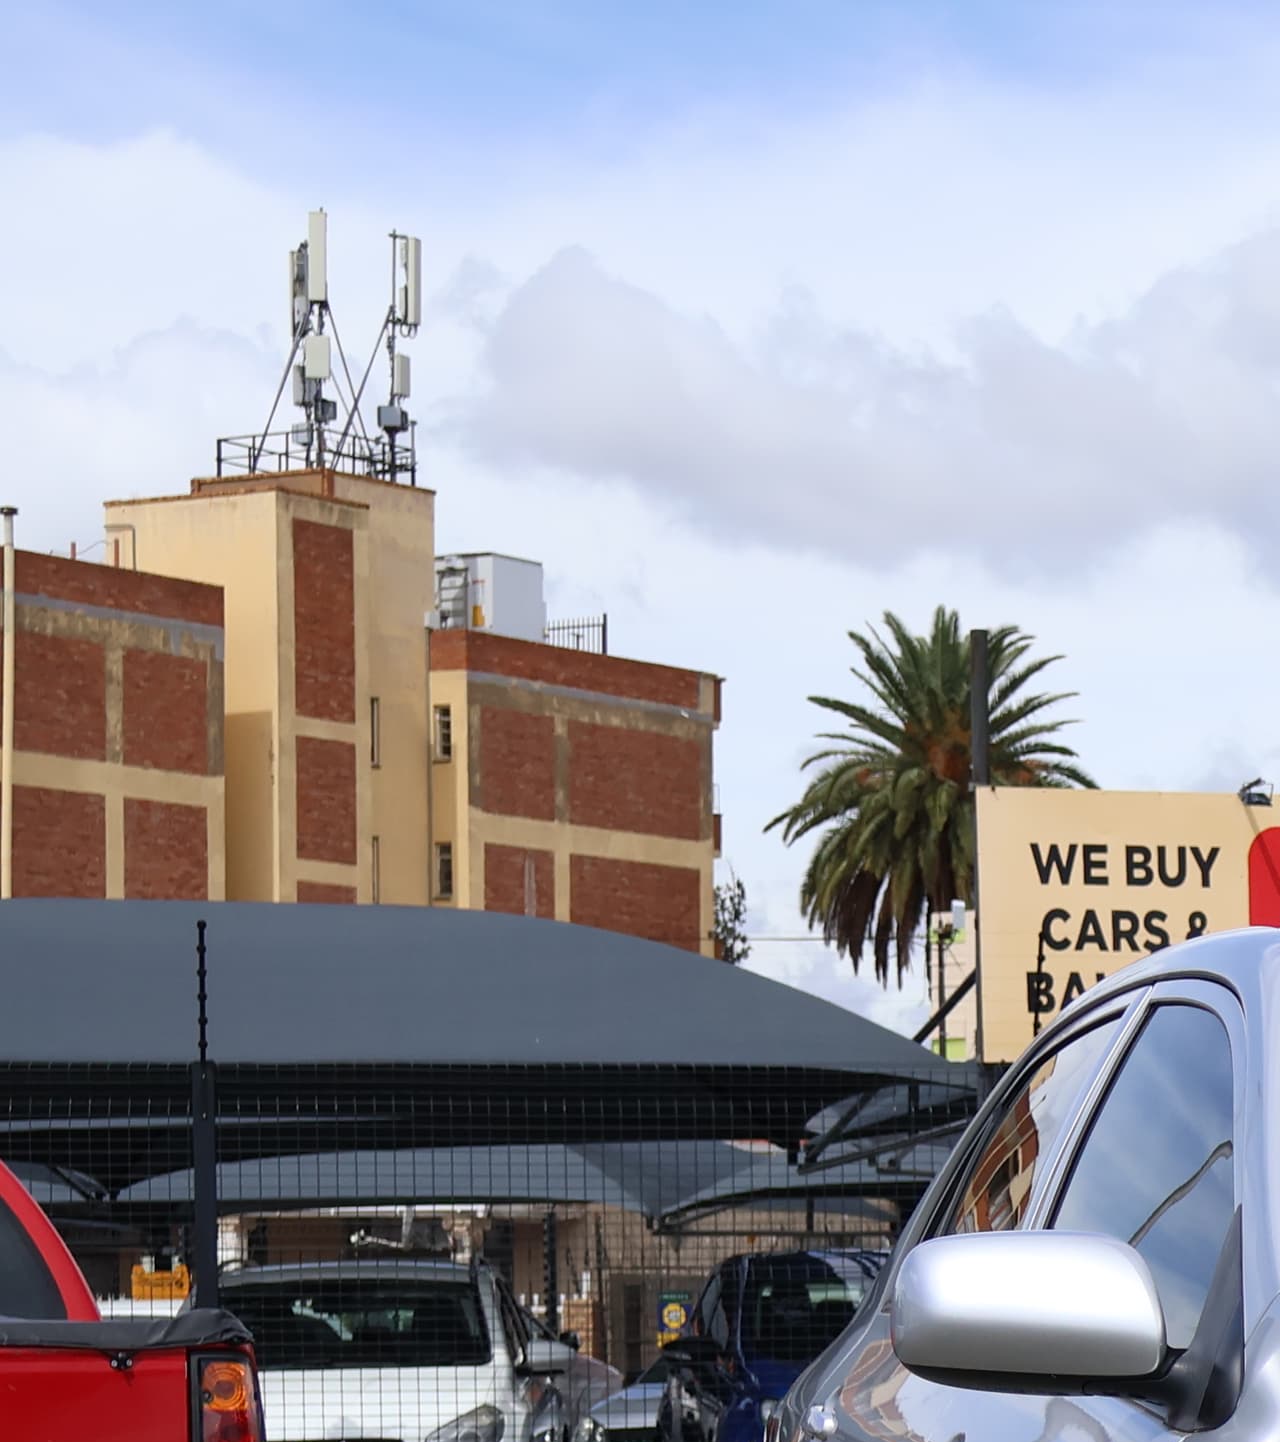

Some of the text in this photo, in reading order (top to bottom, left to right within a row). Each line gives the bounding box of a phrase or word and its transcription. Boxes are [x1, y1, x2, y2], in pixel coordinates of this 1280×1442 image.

[1030, 843, 1221, 888] WE BUY
[1041, 908, 1209, 952] CARS &
